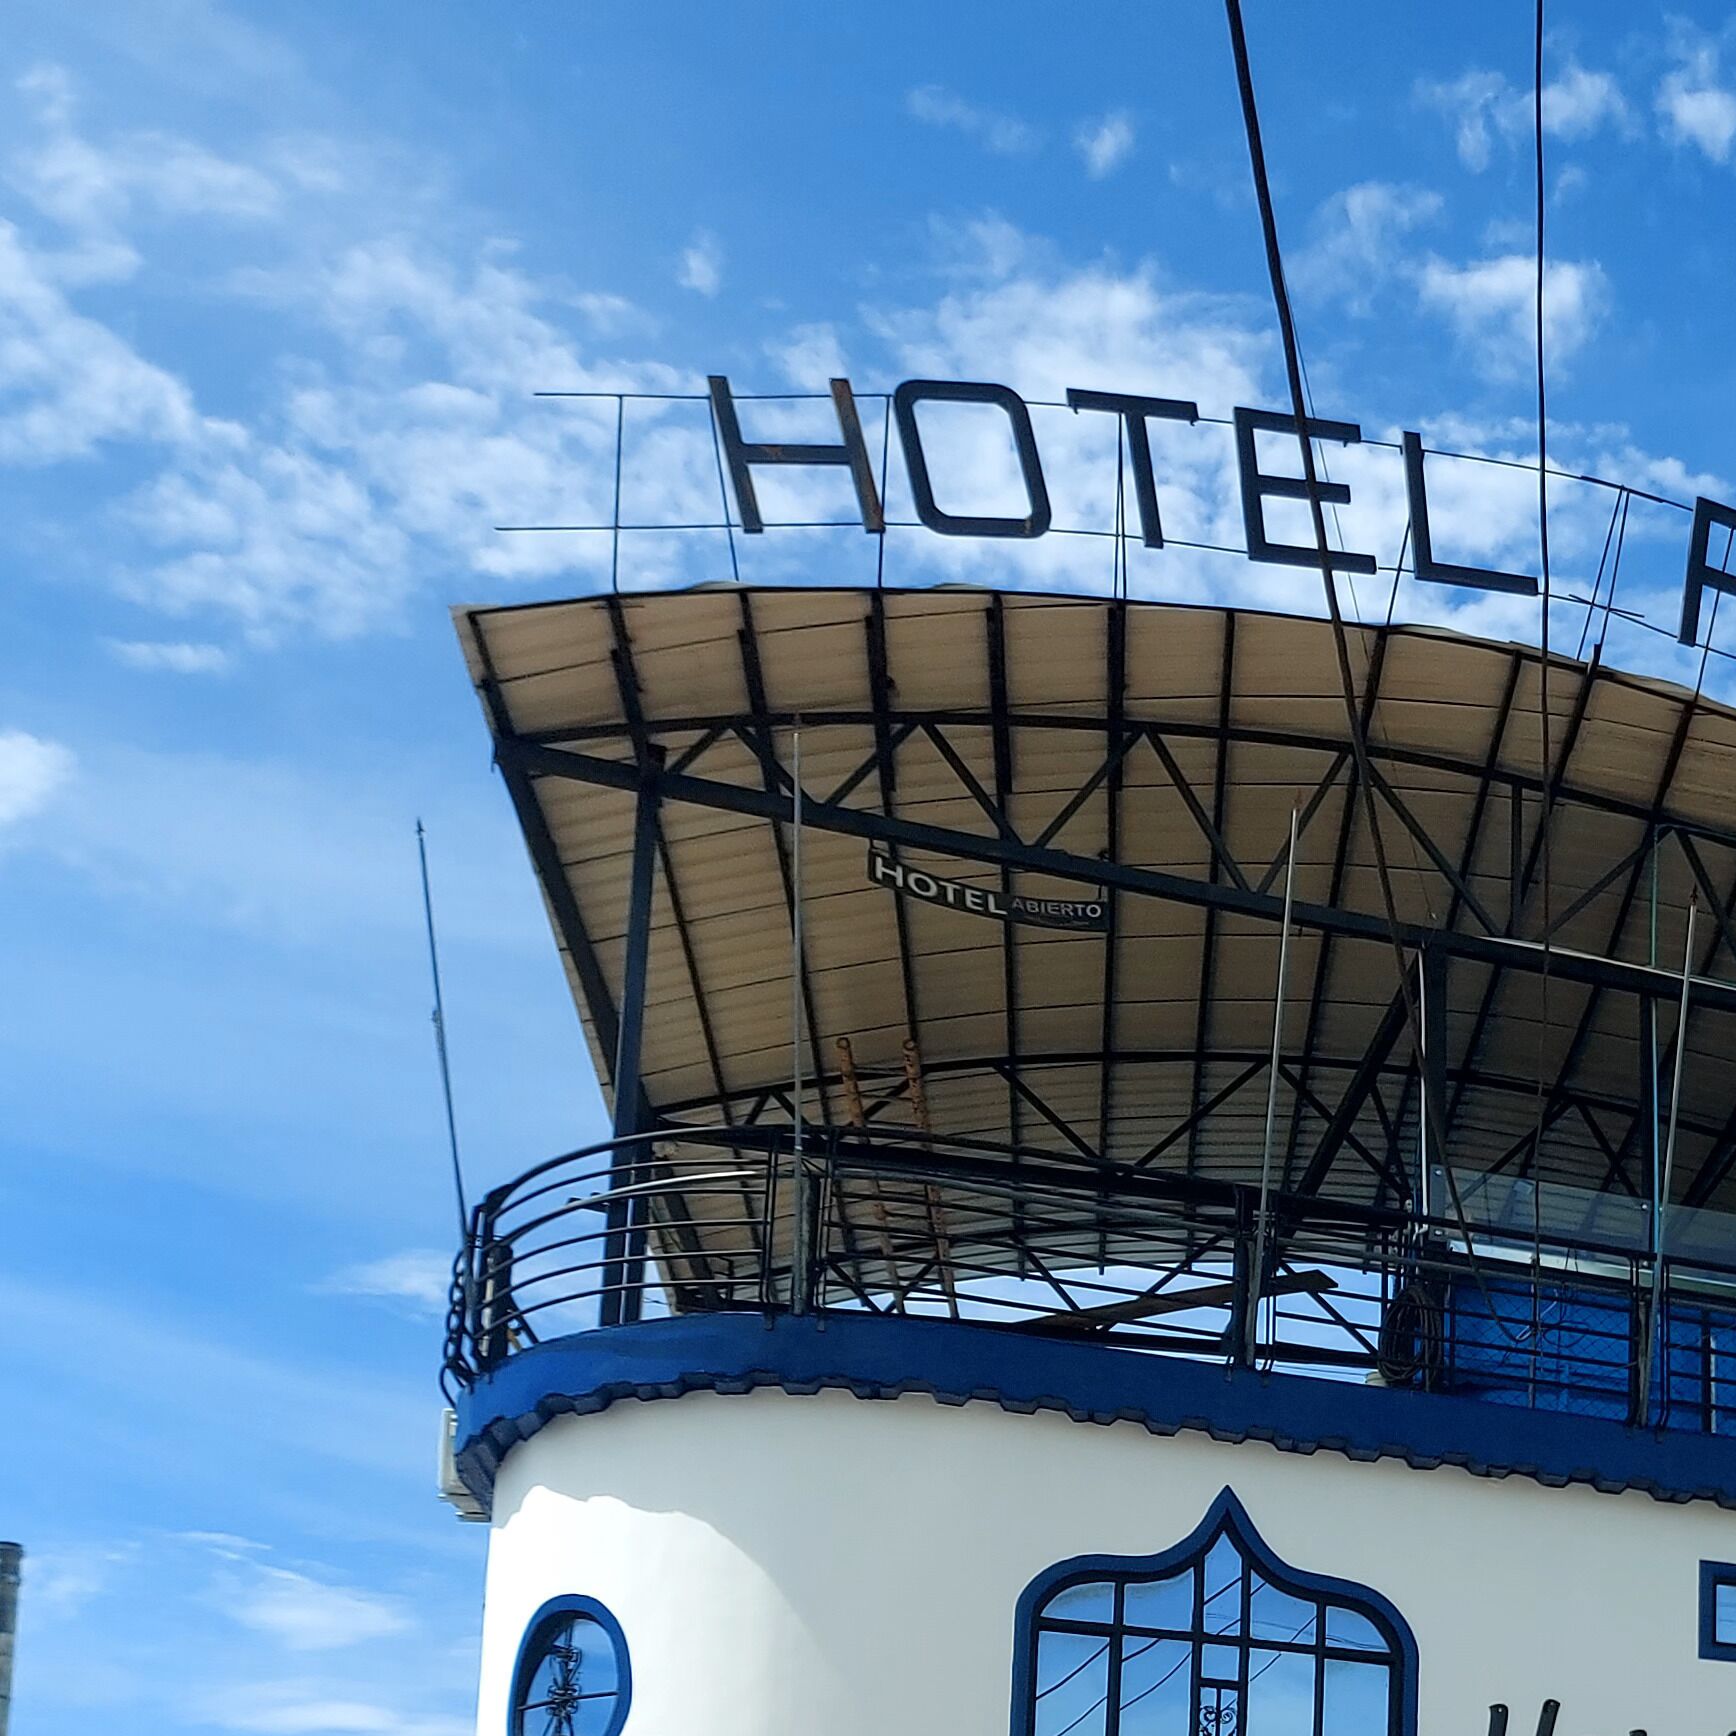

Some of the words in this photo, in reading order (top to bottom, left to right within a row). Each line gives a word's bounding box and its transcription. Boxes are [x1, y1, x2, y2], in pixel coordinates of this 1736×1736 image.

[706, 374, 1540, 597] HOTEL
[875, 856, 1008, 915] HOTEL
[1011, 897, 1101, 918] ABIERTO
